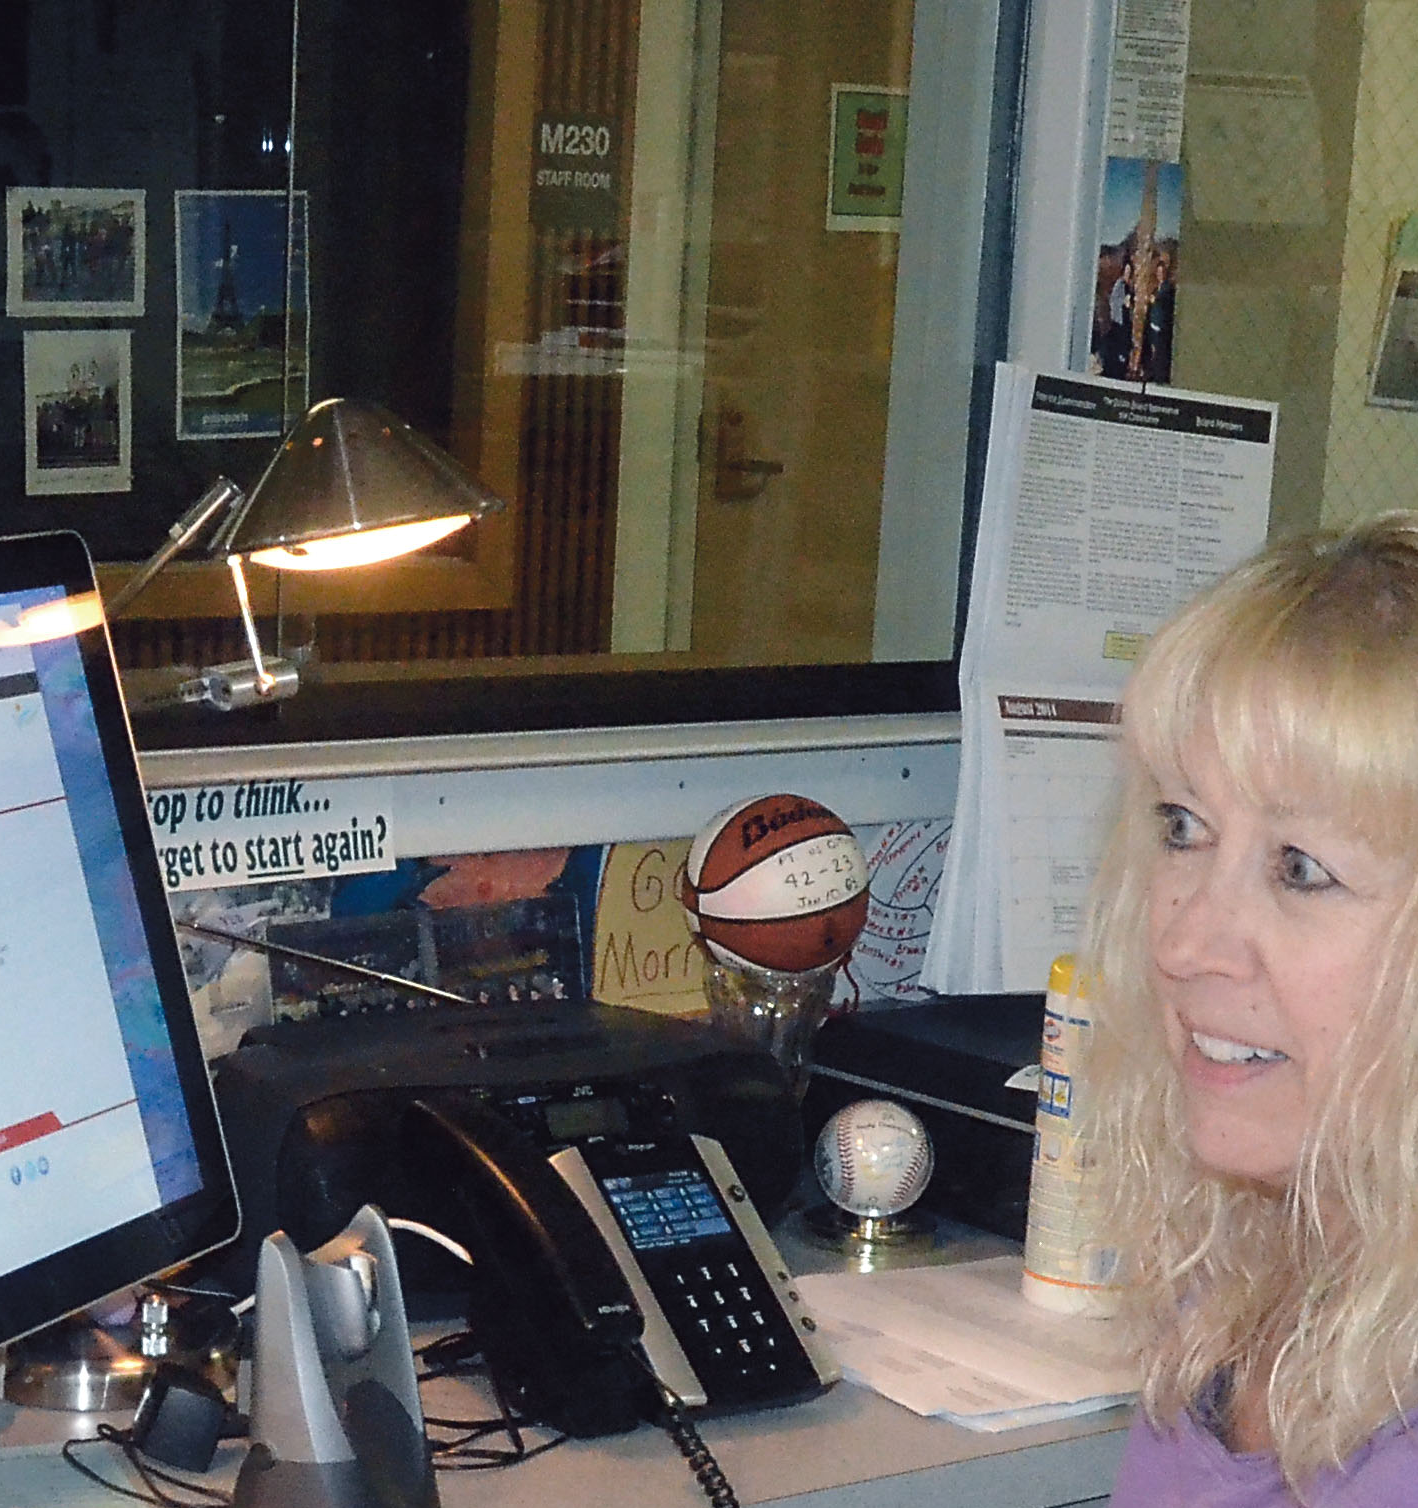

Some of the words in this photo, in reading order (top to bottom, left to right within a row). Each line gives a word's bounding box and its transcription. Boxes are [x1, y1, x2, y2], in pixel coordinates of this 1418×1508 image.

[540, 123, 611, 158] M230
[536, 169, 574, 189] STAFF
[574, 170, 611, 191] ROOM
[148, 785, 187, 834] op
[194, 783, 224, 823] to
[233, 777, 331, 820] think...
[158, 839, 205, 889] get
[209, 836, 238, 875] to
[245, 829, 305, 873] start
[311, 814, 388, 873] again?
